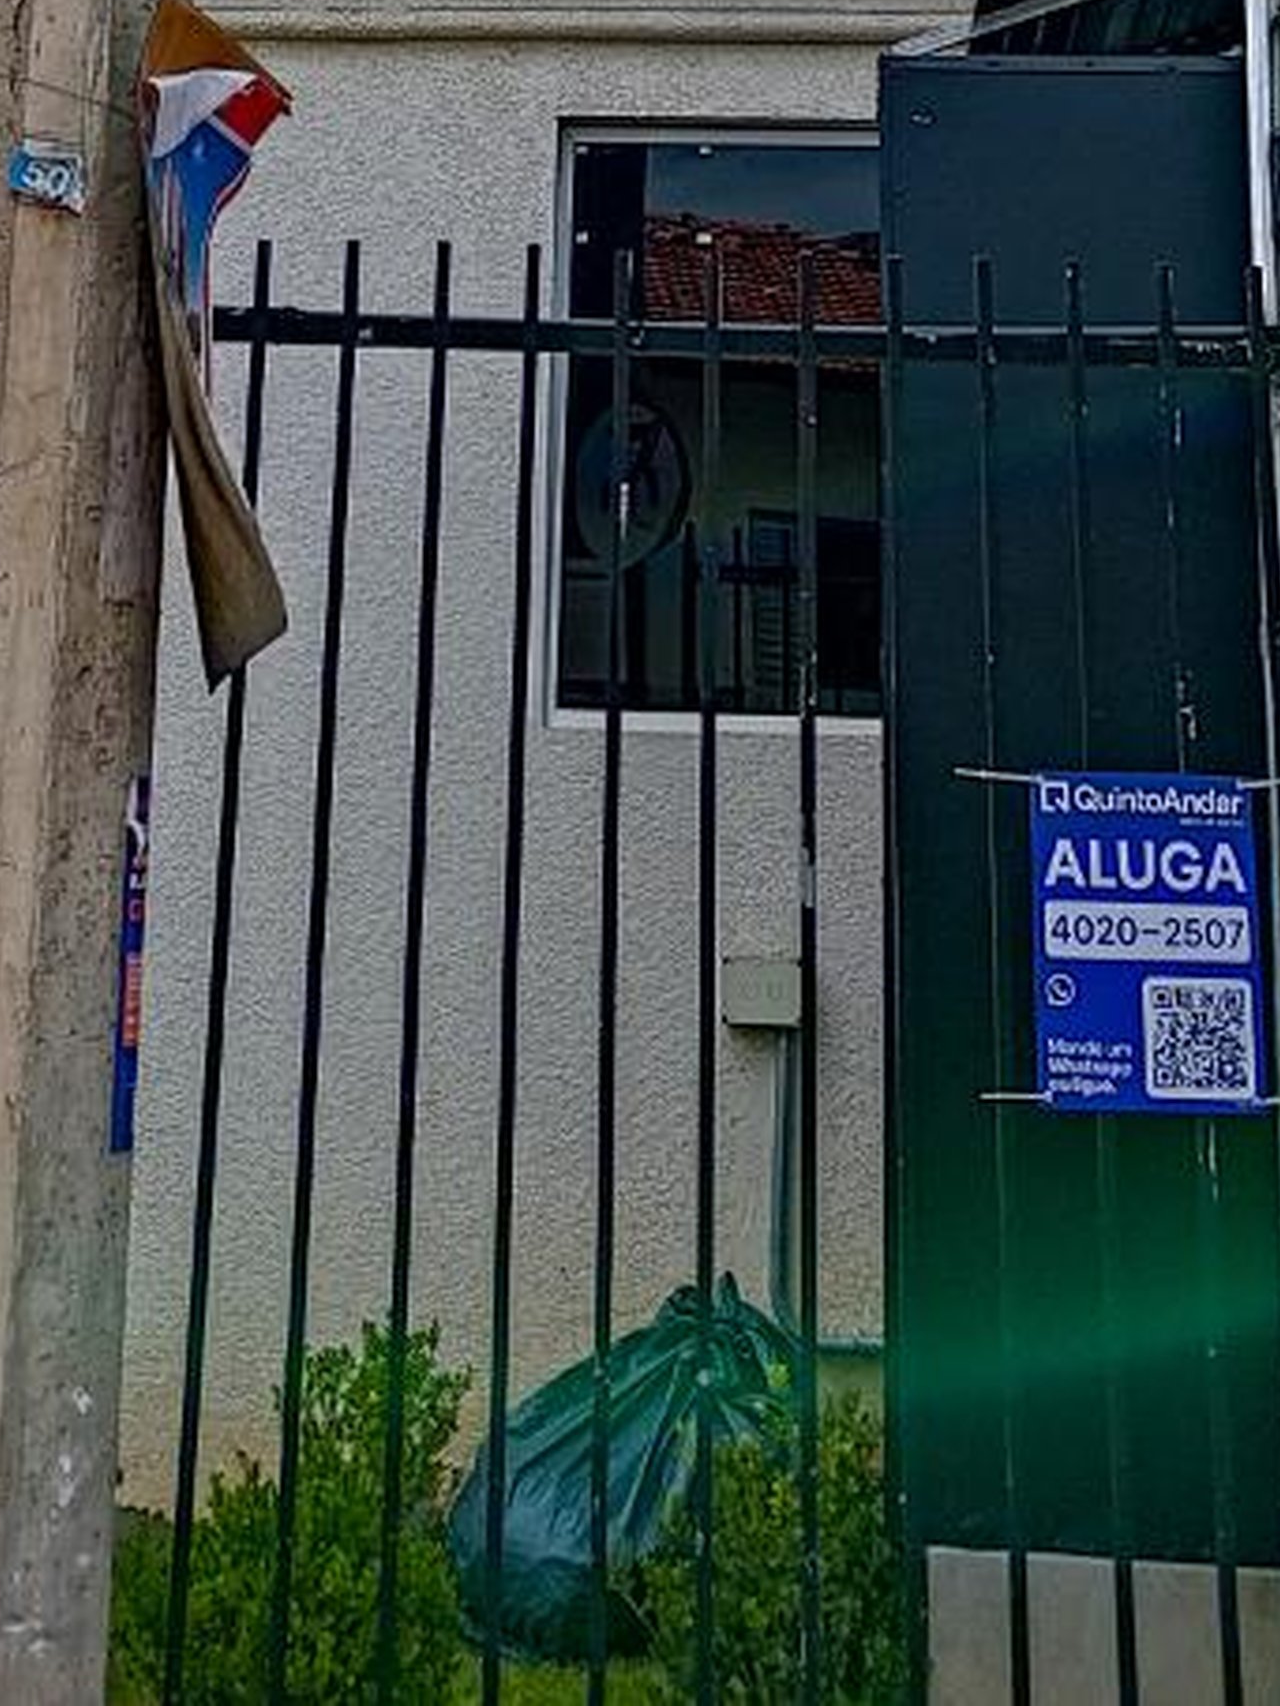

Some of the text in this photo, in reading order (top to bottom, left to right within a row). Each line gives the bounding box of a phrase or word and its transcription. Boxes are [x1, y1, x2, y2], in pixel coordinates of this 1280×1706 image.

[1073, 785, 1244, 816] QuintoAndar
[1044, 839, 1248, 893] ALUGA
[1051, 914, 1245, 949] 4020-2507
